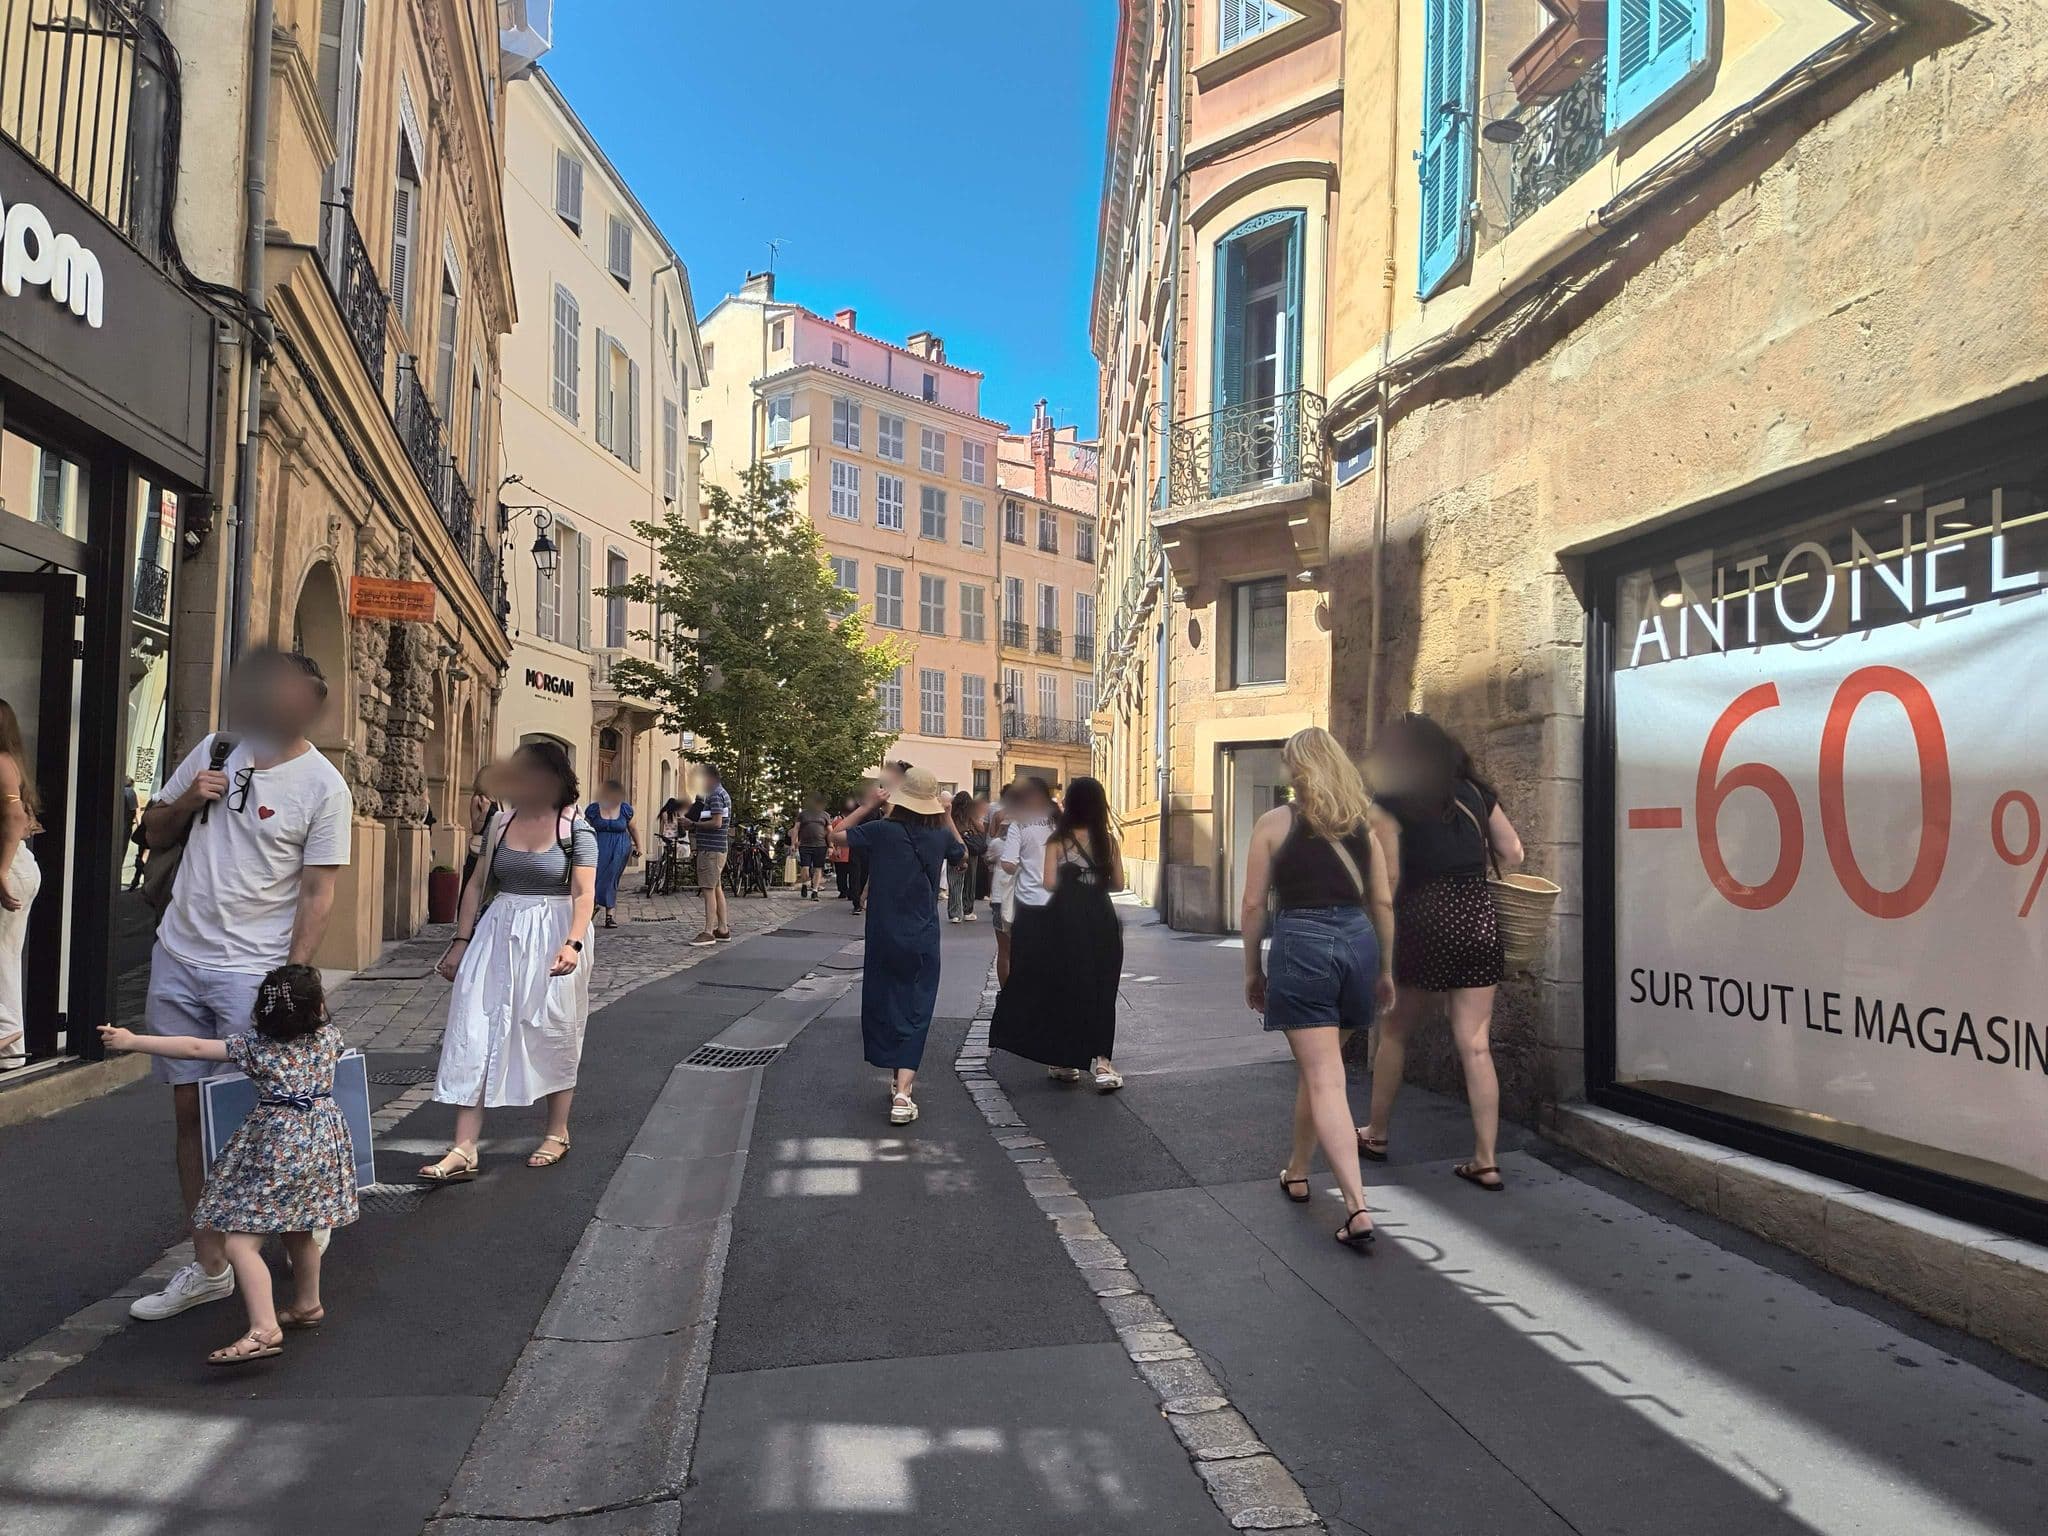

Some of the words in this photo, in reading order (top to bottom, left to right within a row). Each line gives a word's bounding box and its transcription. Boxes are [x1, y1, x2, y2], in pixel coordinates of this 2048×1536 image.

[0, 190, 104, 328] pm
[525, 668, 574, 698] MORGAN
[1630, 967, 1694, 1010] SUR
[1699, 975, 1794, 1024] TOUT
[1805, 988, 1843, 1035] LE
[1855, 996, 2048, 1076] MAGASIN
